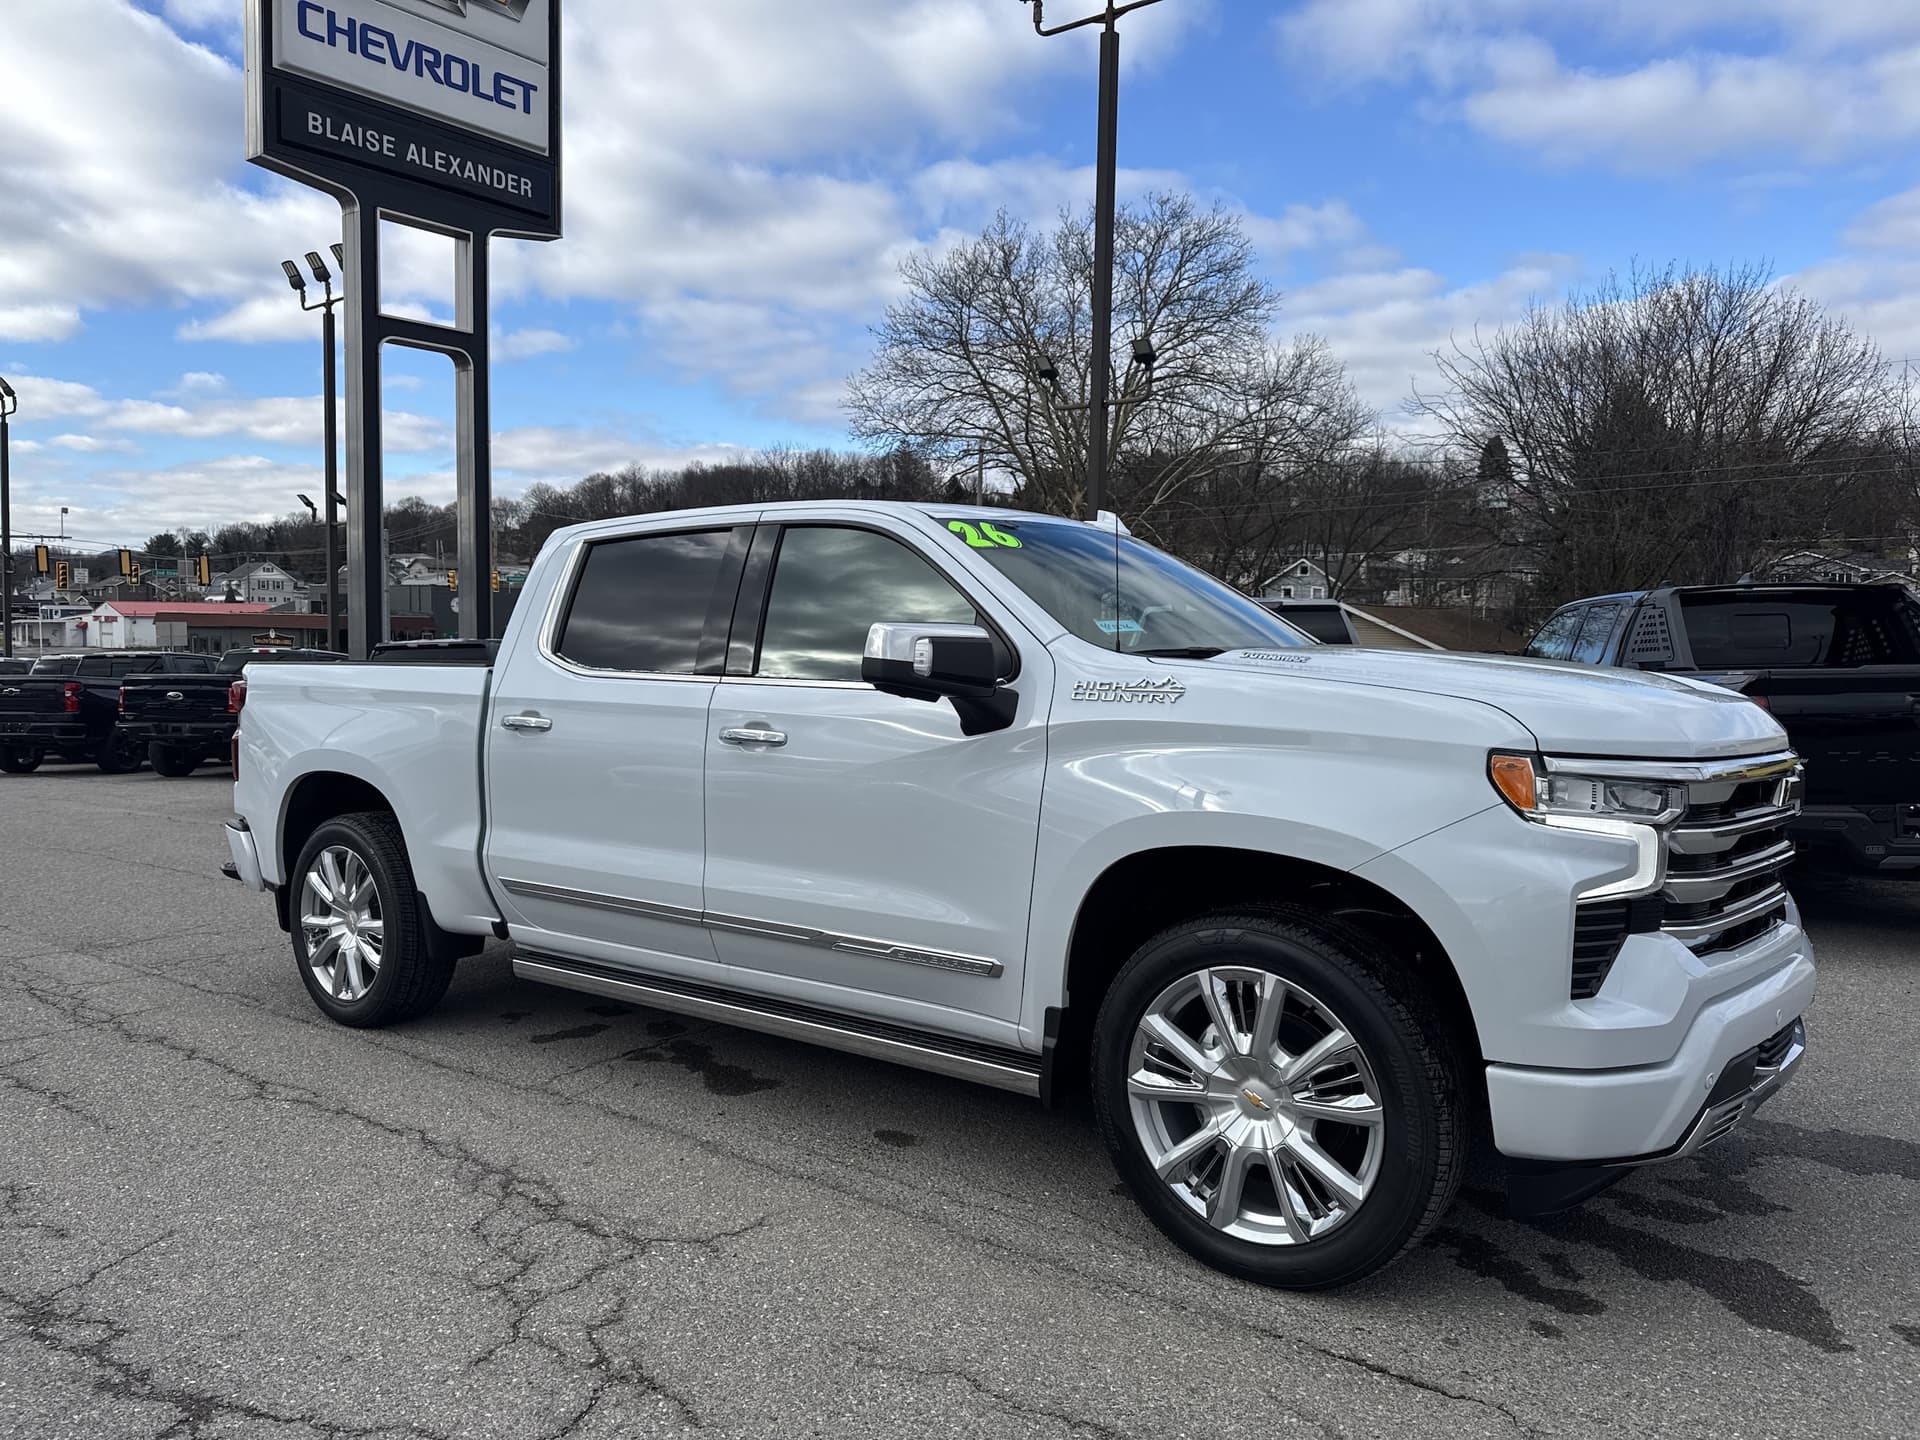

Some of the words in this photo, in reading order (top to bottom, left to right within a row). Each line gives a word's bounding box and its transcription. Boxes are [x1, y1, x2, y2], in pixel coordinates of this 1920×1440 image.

[297, 1, 538, 114] CHEVROLET
[308, 111, 397, 157] BLAISE
[406, 143, 533, 198] ALEXANDER
[948, 520, 1023, 549] 26
[1071, 691, 1185, 703] COUNTRY
[1073, 680, 1129, 691] HIGH
